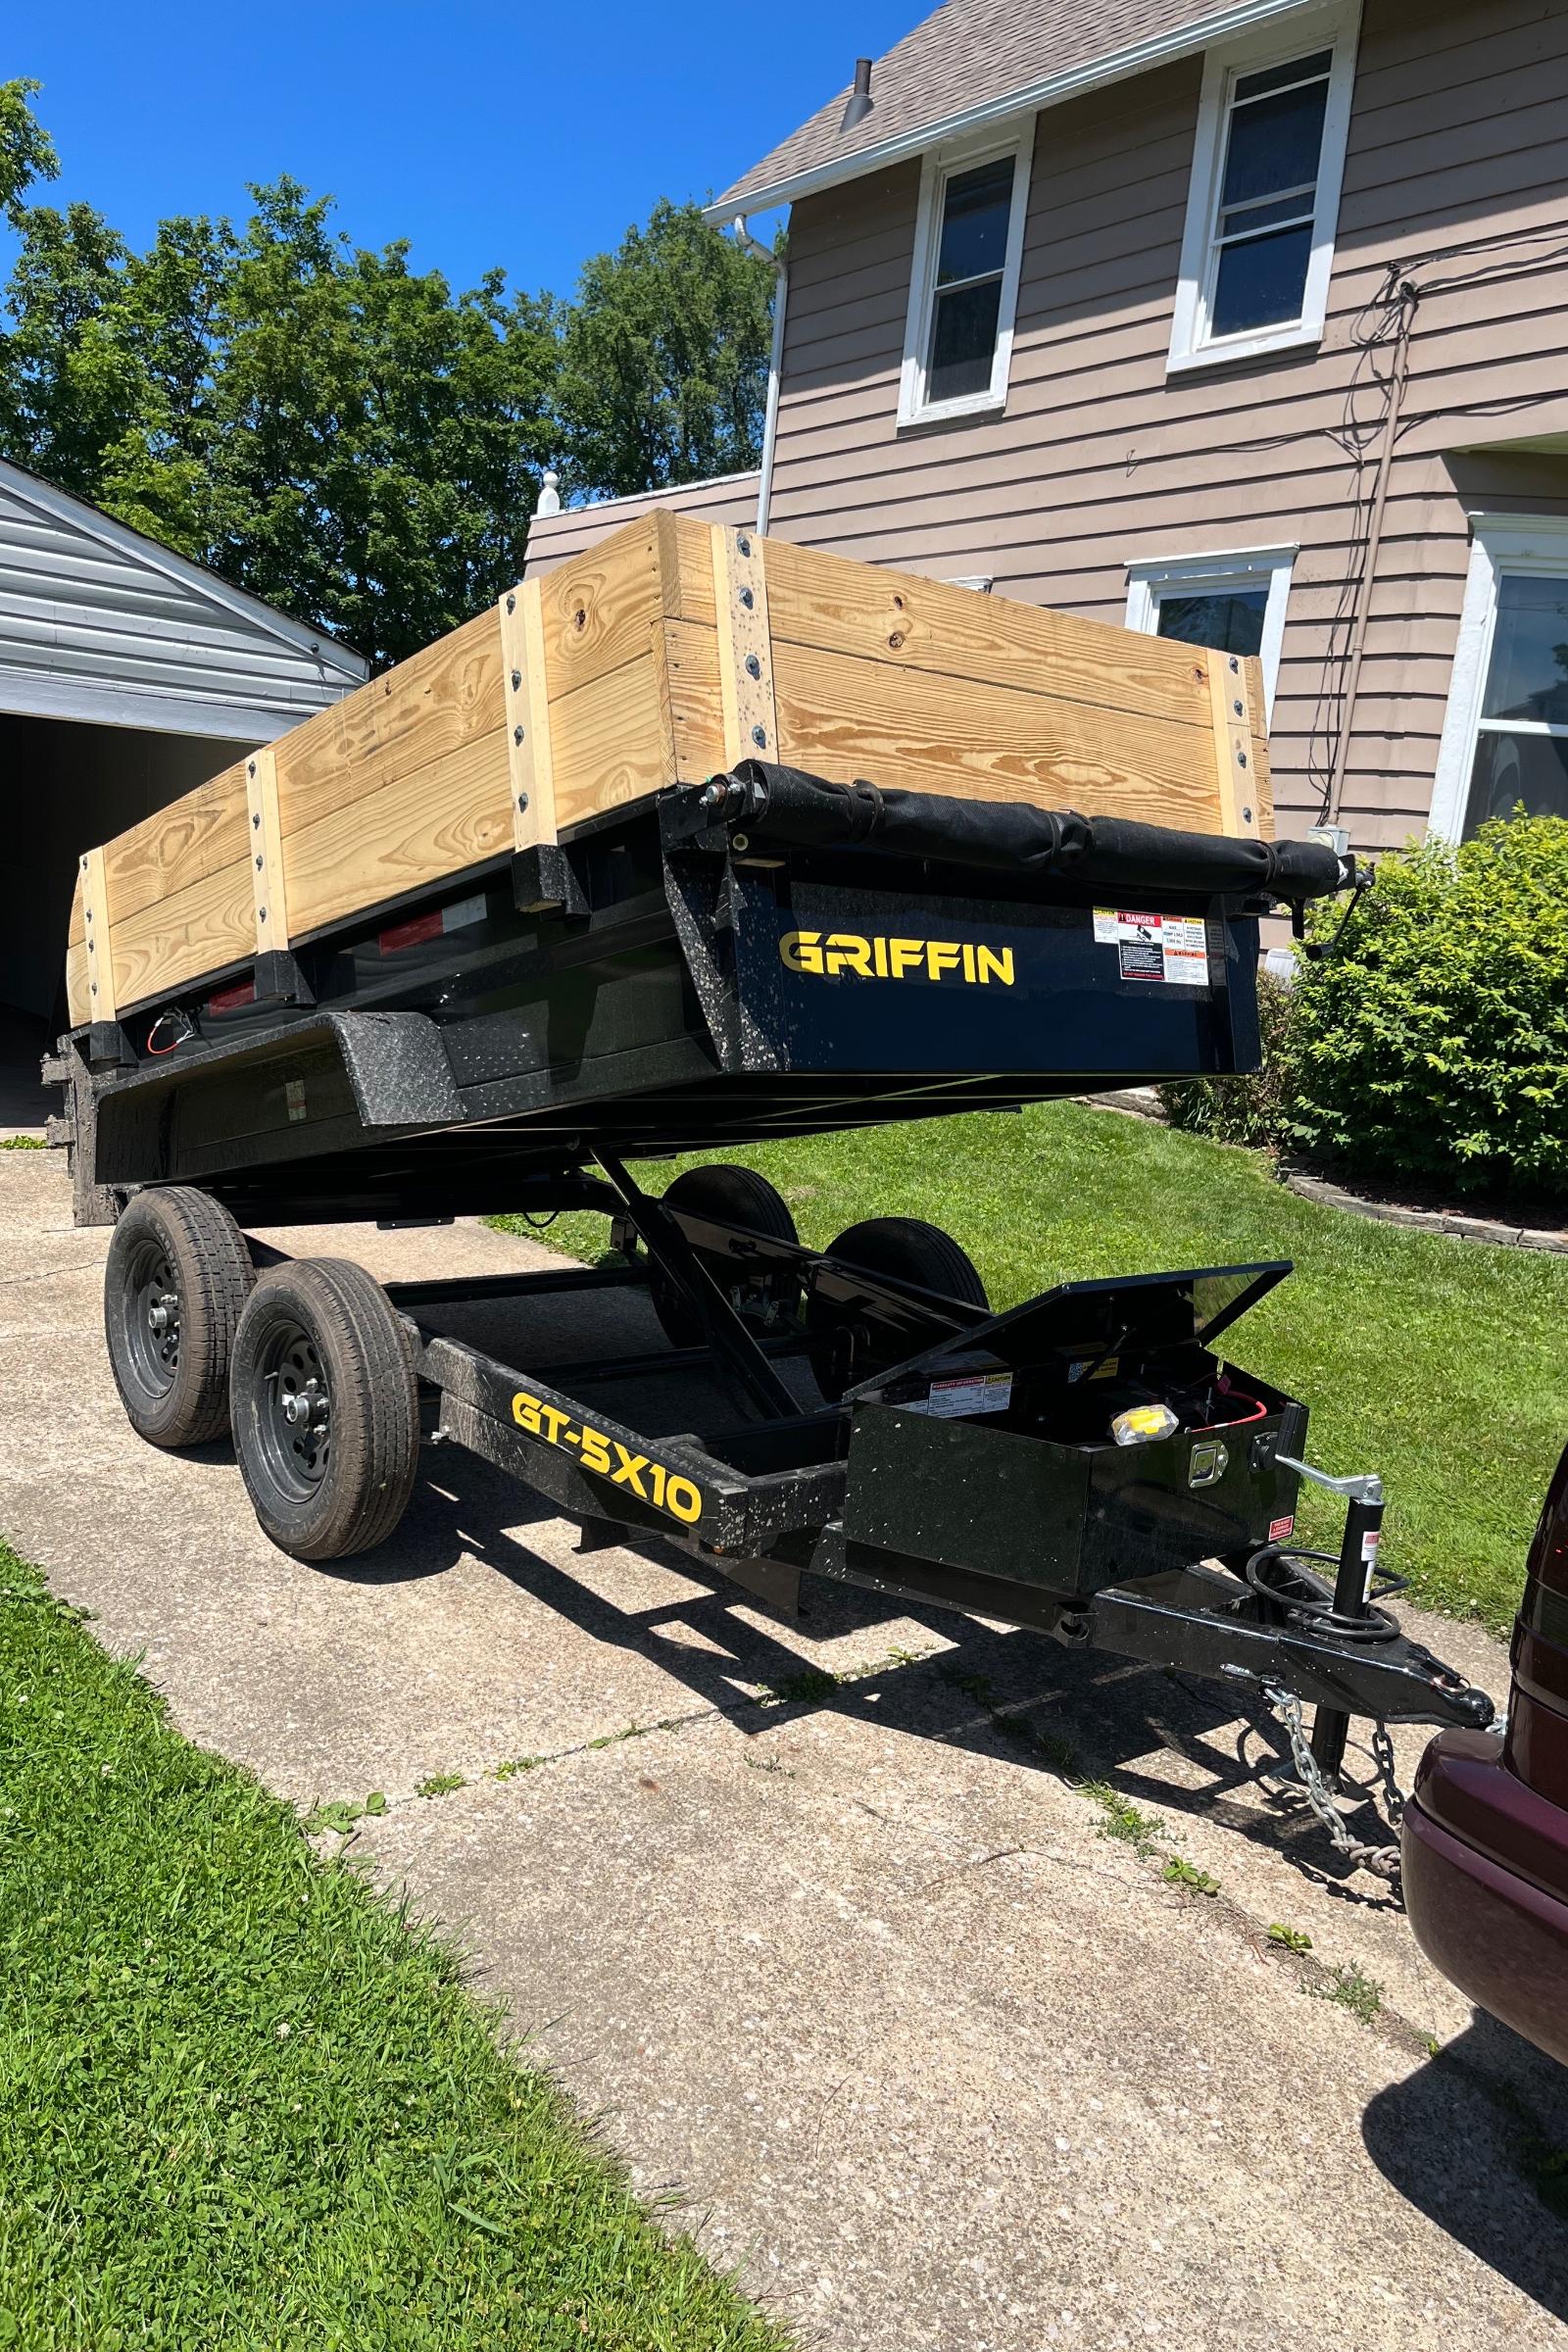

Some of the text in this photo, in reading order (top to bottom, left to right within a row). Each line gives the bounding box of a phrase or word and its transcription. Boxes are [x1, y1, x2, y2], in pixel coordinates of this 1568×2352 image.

[1126, 913, 1155, 925] DANGER
[779, 931, 1015, 986] GRIFFIN
[512, 1392, 703, 1523] GT-5X10
